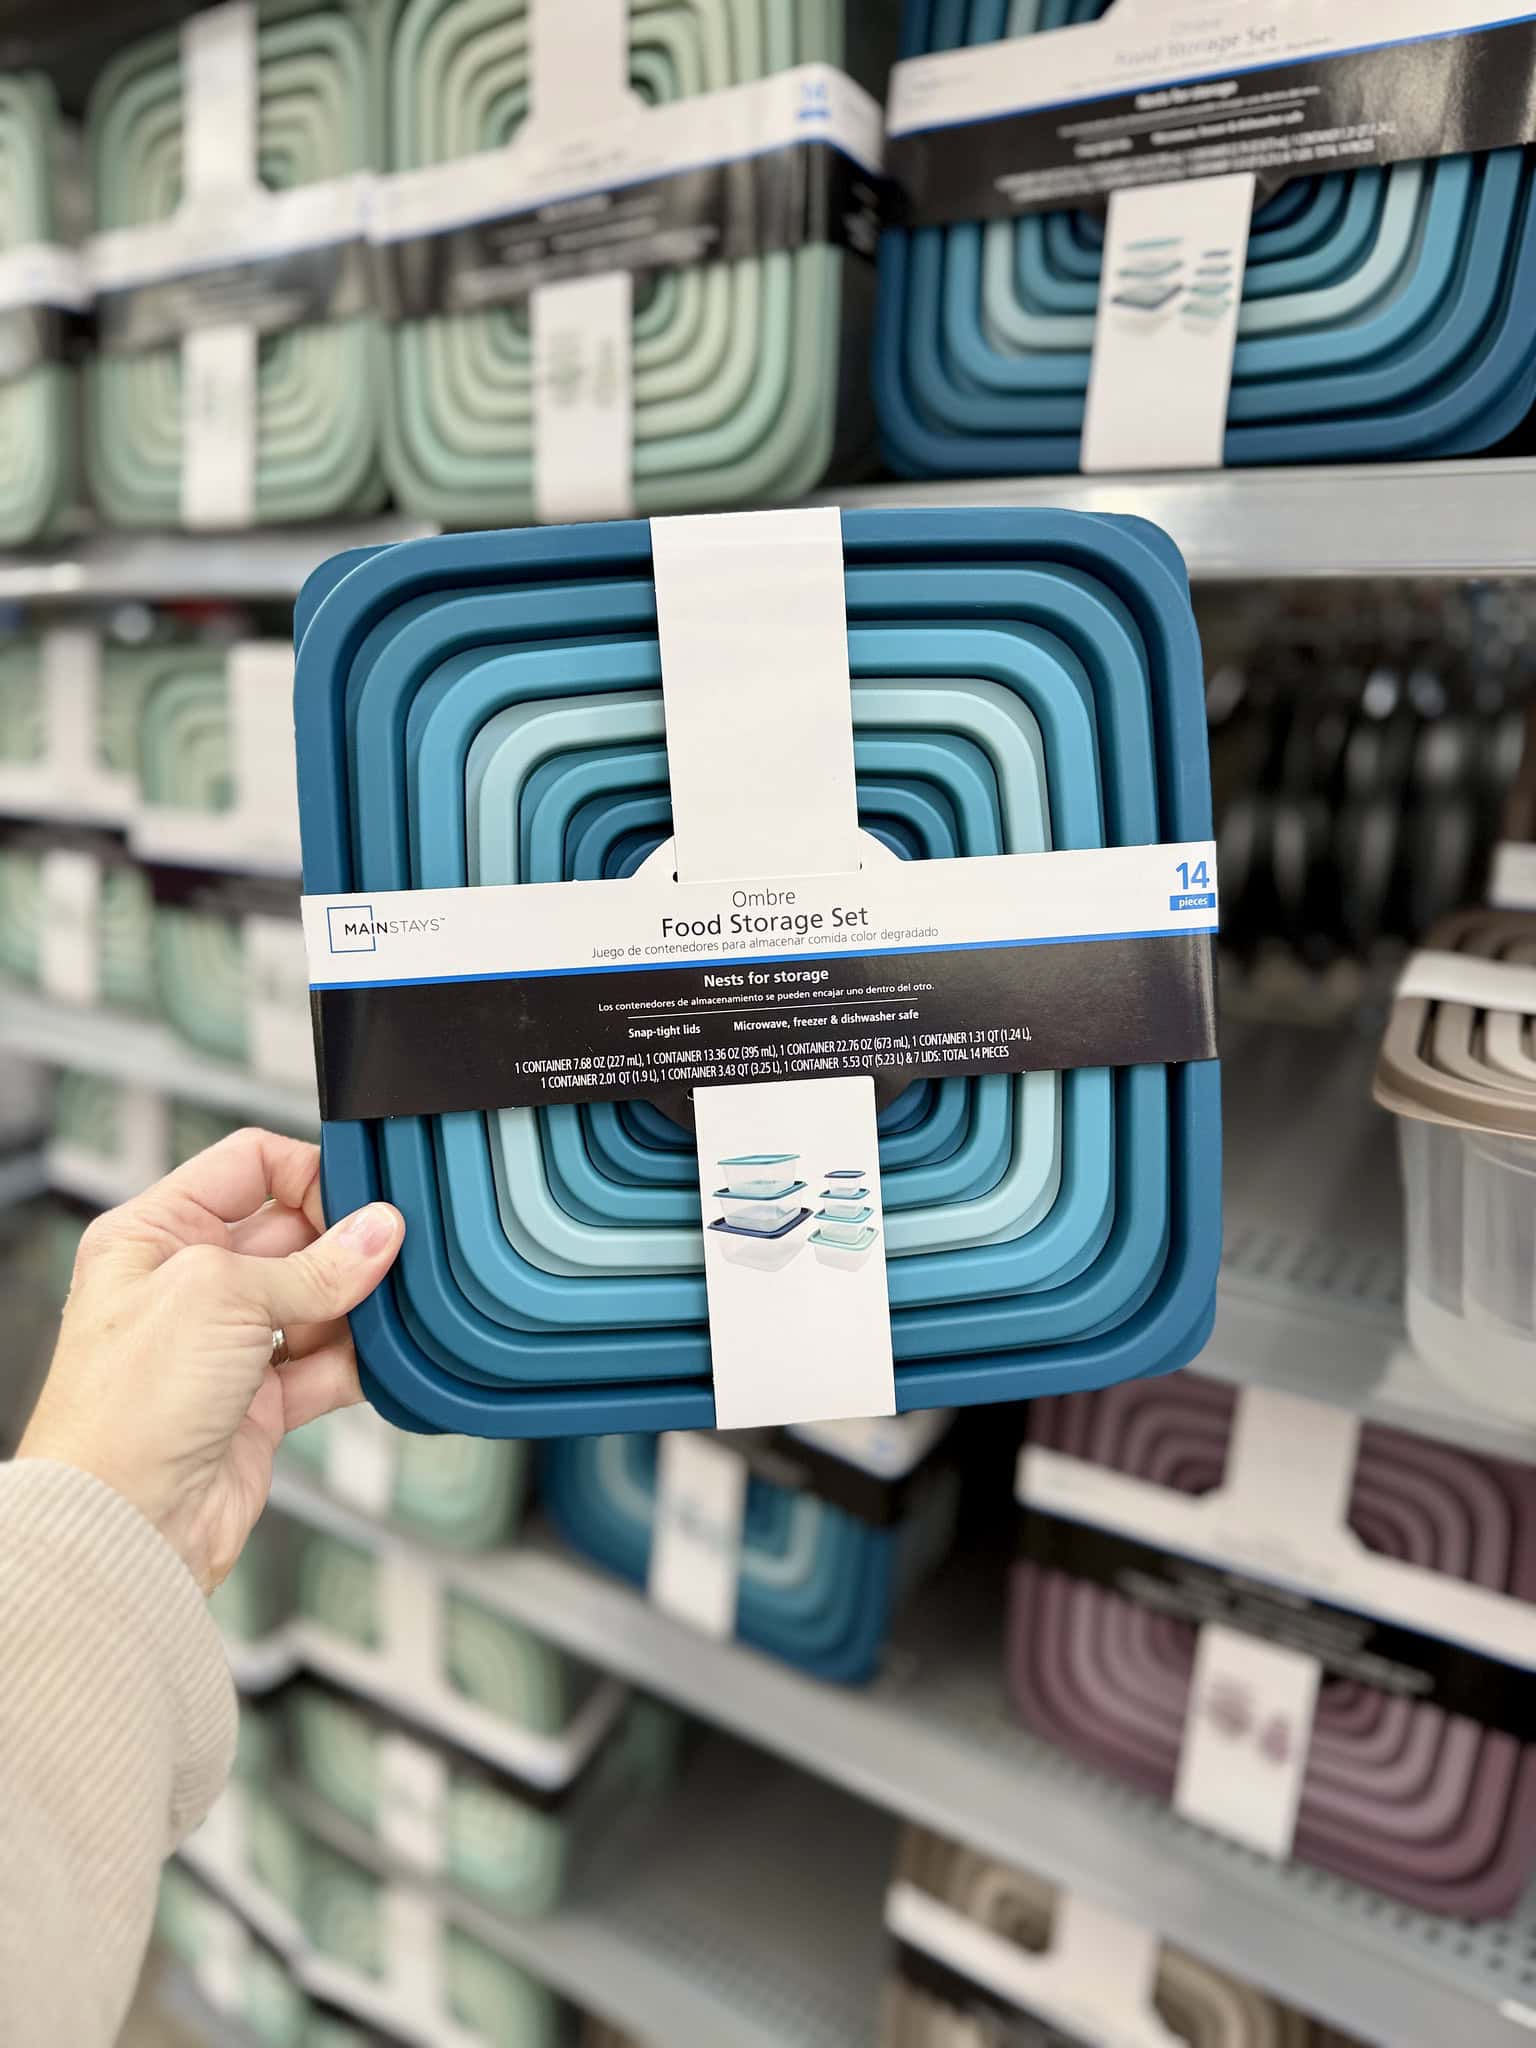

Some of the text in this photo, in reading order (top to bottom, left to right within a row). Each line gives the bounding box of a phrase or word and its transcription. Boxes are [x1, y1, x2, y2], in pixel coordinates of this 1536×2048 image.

[1176, 860, 1210, 890] 14
[732, 888, 796, 908] Ombre
[1178, 896, 1208, 909] pieces
[662, 907, 869, 938] Food Storage Set
[592, 925, 939, 960] Juego de contenedores para almacenar comida color degradado
[704, 969, 829, 988] Nests for storage
[598, 982, 935, 1012] Los contenedores de almacenamiento se pueden encajar uno dentro del otro.
[628, 1023, 701, 1039] Snap-tight lids
[733, 1008, 920, 1032] Microwave, freezer & dishwasher safe
[514, 1062, 520, 1074] 1
[522, 1059, 572, 1074] CONTAINER
[573, 1057, 592, 1070] 7.68
[593, 1056, 605, 1068] OZ
[606, 1055, 625, 1069] (227
[646, 1054, 651, 1065] 1
[653, 1050, 703, 1065] CONTAINER
[704, 1048, 727, 1061] 13.36
[727, 1047, 740, 1060] OZ
[741, 1046, 760, 1061] (395
[780, 1044, 784, 1057] 1
[786, 1041, 835, 1056] CONTAINER
[836, 1039, 859, 1052] 22.76
[860, 1038, 873, 1051] OZ
[874, 1036, 892, 1051] (673
[912, 1035, 917, 1047] 1
[919, 1032, 967, 1046] CONTAINER
[968, 1030, 985, 1043] 1.31
[986, 1029, 1000, 1043] QT
[1001, 1028, 1021, 1043] (1.24
[1022, 1027, 1032, 1041] L),
[541, 1045, 1010, 1089] 1 CONTAINER 2.01 QT (1.9 L), 1 CONTAINER 3.43 QT (3.25 L), 1 CONTAINER 5.53 QT (5.23 L) & 7 LIDS: TOTAL 14 PIECES
